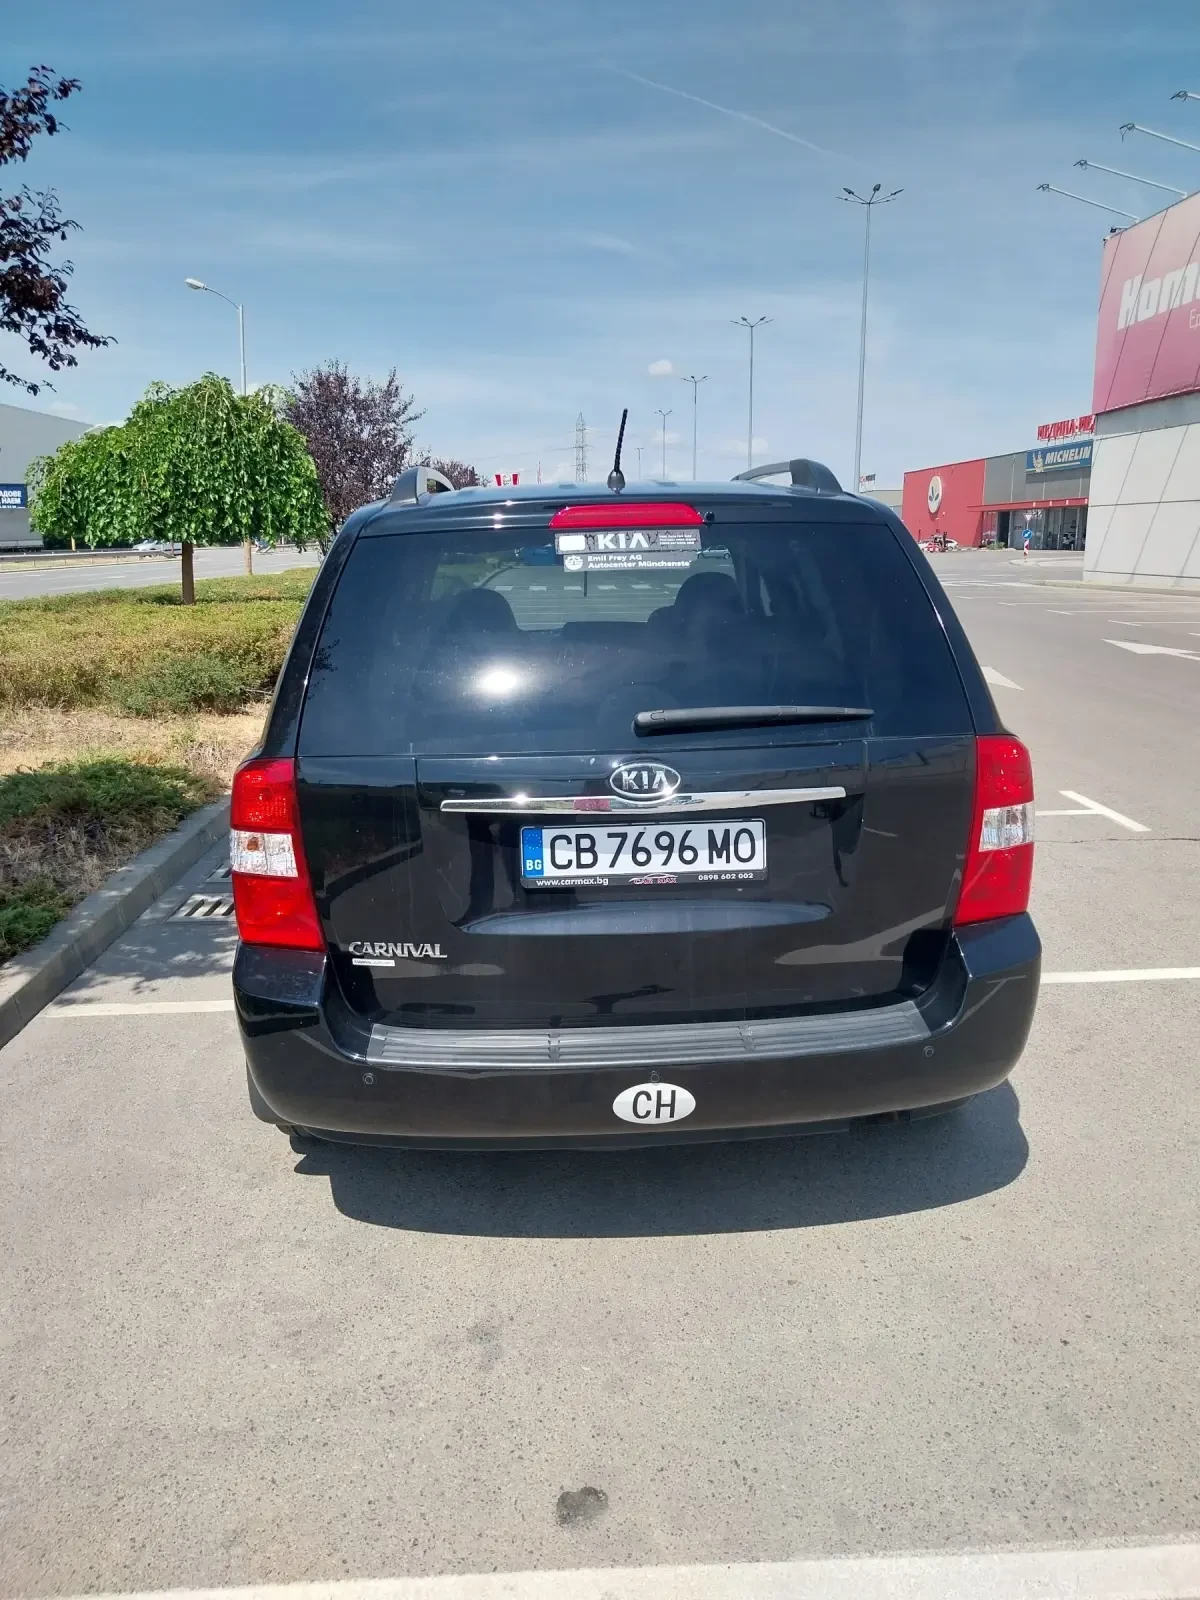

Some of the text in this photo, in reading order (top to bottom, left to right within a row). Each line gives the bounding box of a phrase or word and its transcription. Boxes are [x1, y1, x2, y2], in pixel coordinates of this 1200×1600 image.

[1045, 446, 1091, 465] MICHELIN
[597, 532, 649, 550] KIA
[587, 561, 637, 569] Autocenter
[621, 770, 669, 790] KIA
[549, 828, 757, 870] CB 7696 MO
[525, 859, 543, 871] BG
[535, 876, 609, 887] www.carmax.bg
[738, 872, 754, 880] 002
[348, 941, 448, 959] CARNIVAL
[632, 1089, 677, 1120] CH
